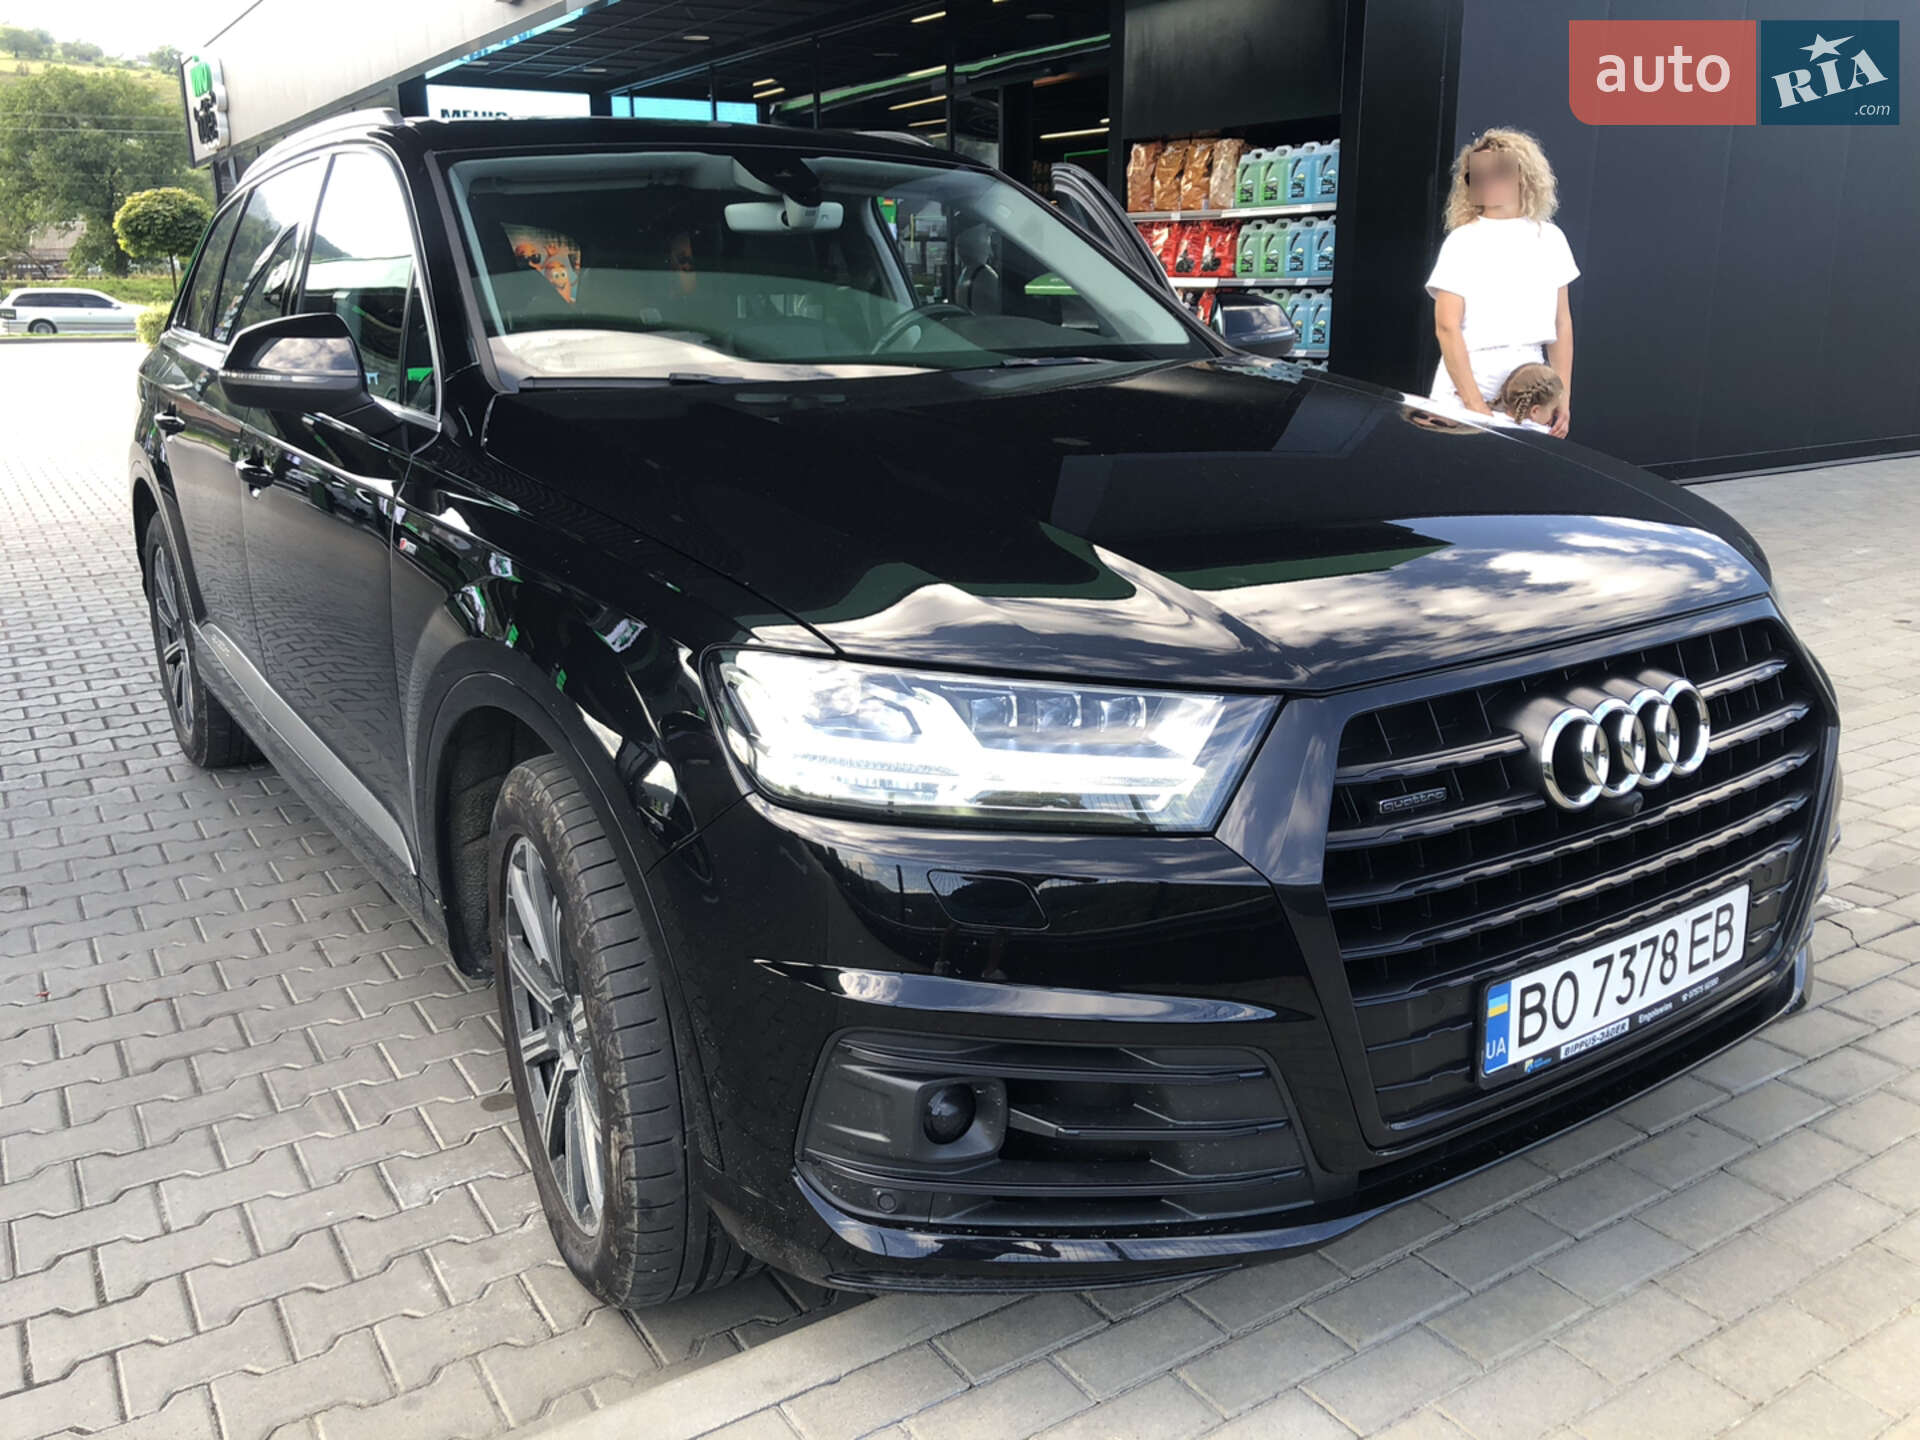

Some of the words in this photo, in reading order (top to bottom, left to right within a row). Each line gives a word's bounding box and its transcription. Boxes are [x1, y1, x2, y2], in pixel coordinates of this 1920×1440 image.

[1518, 970, 1580, 1048] BO
[1593, 928, 1679, 1018] 7378
[1688, 902, 1735, 975] EB
[1486, 1036, 1506, 1060] UA
